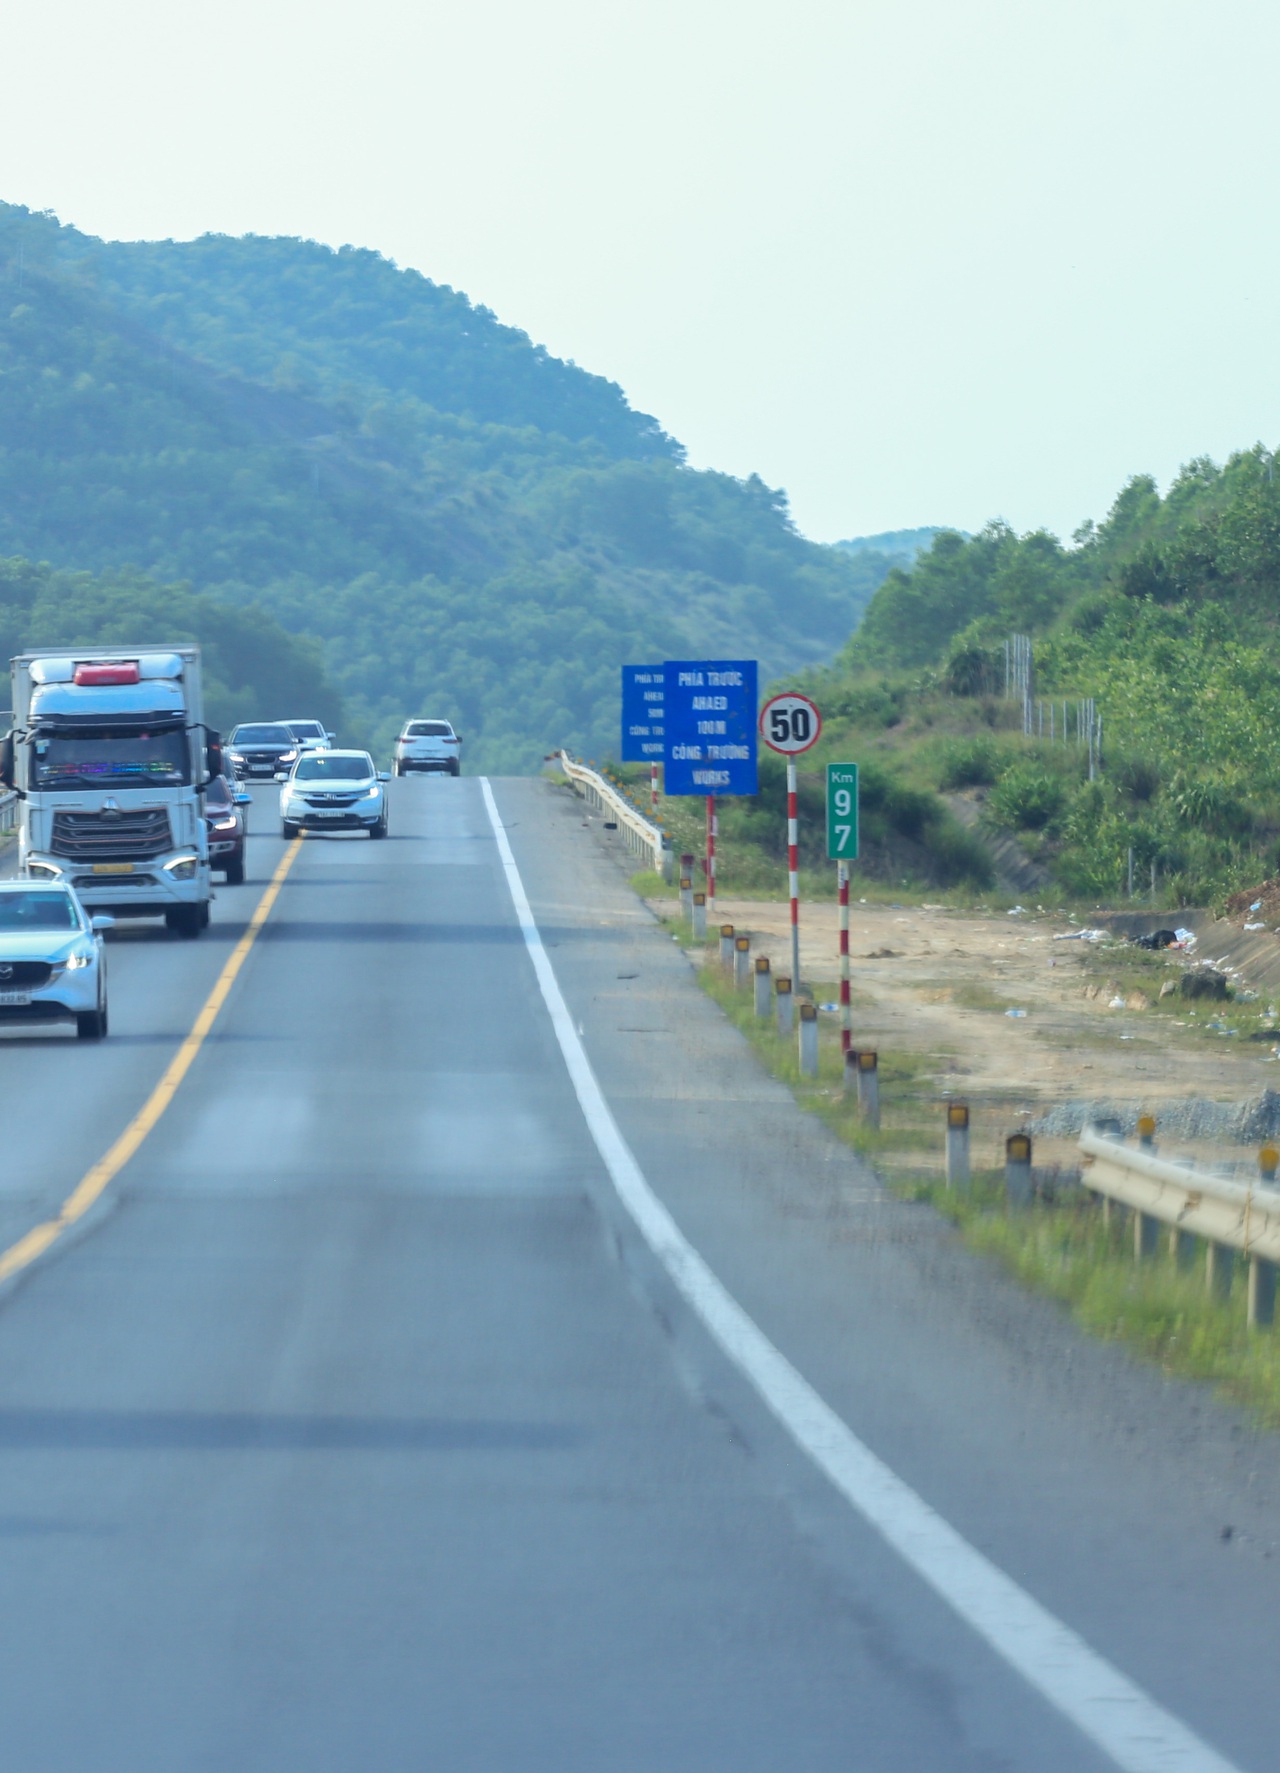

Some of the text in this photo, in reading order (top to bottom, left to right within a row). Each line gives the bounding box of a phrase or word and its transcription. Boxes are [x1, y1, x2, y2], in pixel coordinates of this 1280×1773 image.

[771, 708, 809, 742] 50
[692, 770, 731, 785] WORKS
[831, 772, 853, 783] Km
